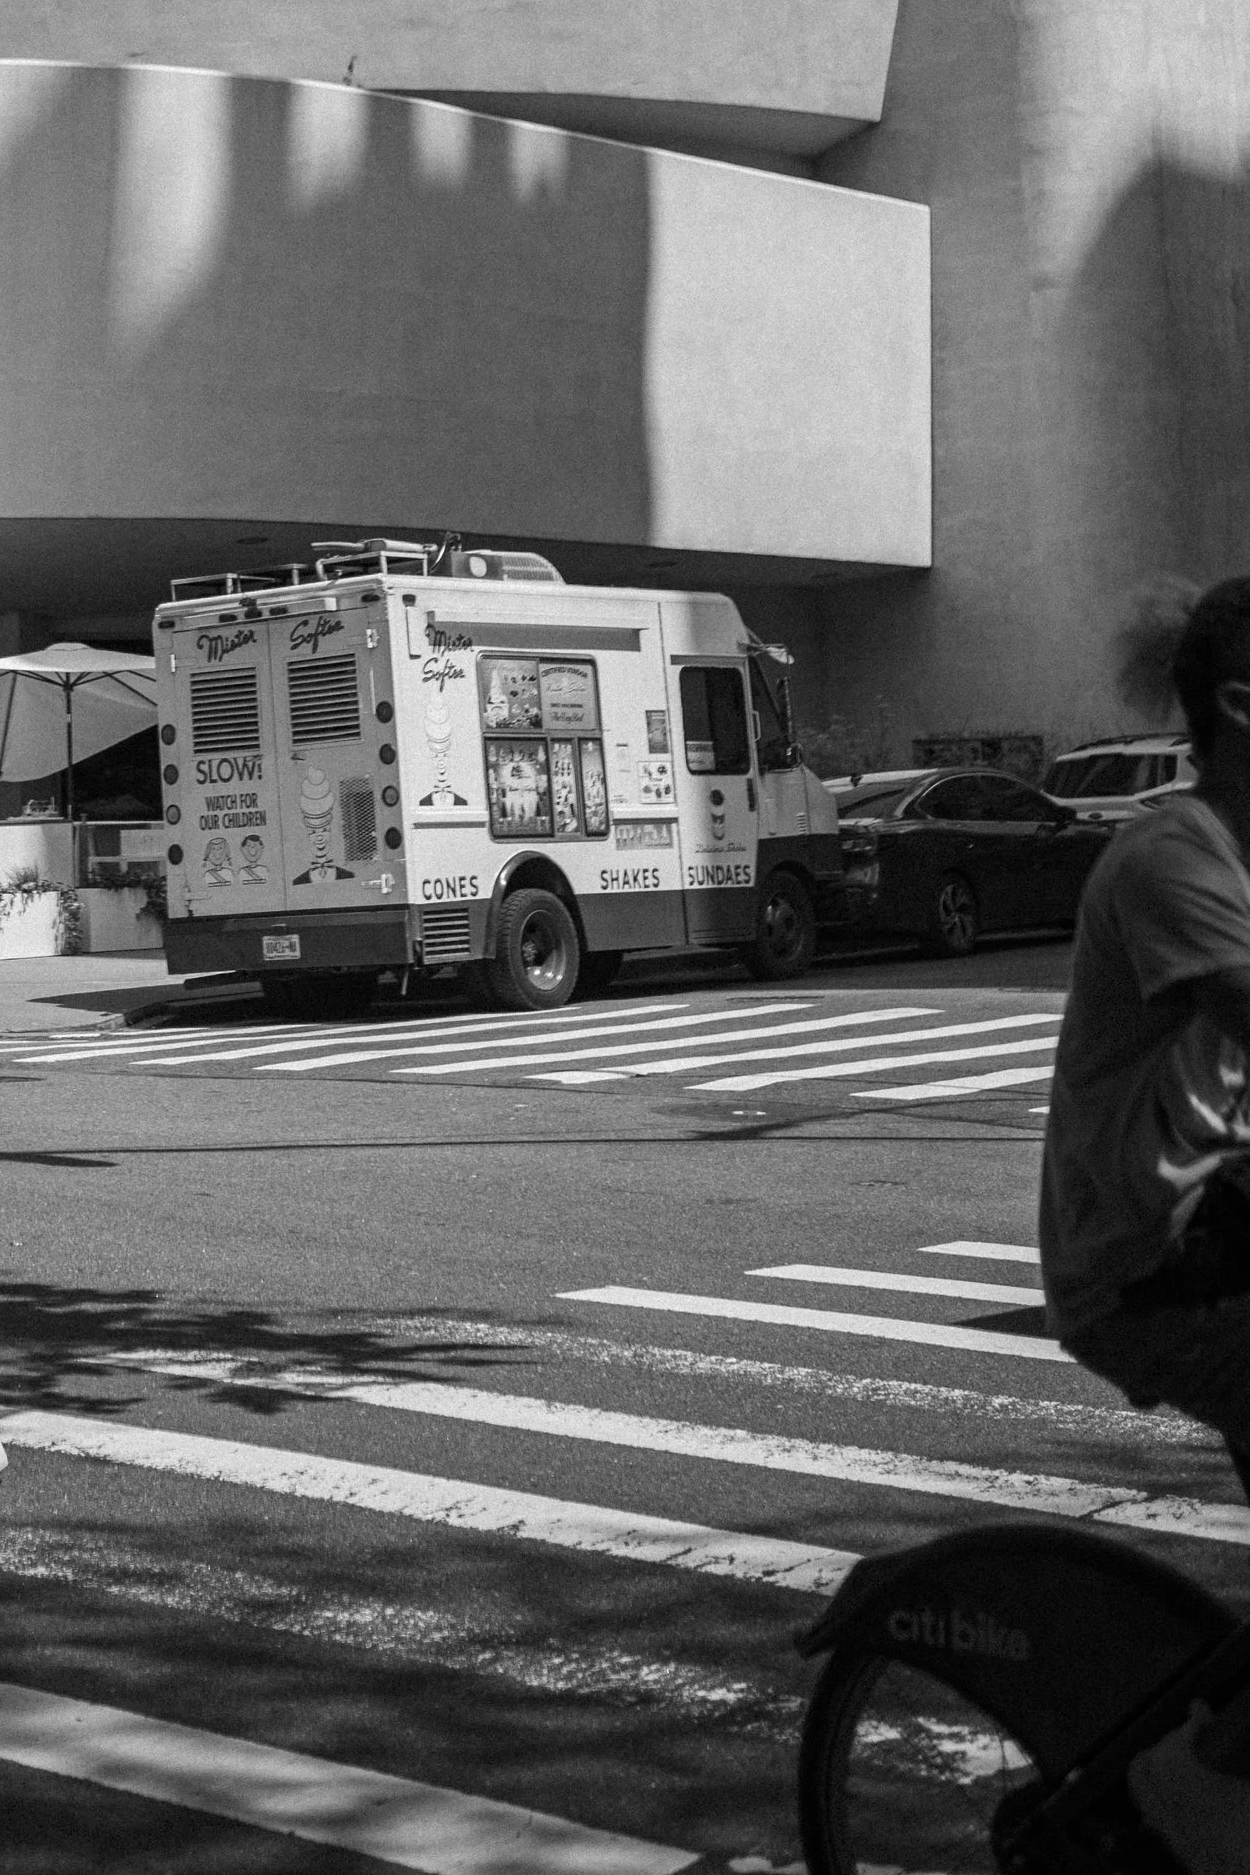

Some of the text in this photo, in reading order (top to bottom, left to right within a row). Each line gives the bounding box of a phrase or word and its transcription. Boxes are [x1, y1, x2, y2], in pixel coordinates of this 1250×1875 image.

[196, 615, 345, 663] Mister Softee
[424, 623, 475, 657] Mister
[422, 657, 466, 693] Softee
[196, 756, 263, 785] SLOW!
[204, 792, 259, 812] WATCH FOR
[199, 809, 267, 831] OUR CHILDREN
[421, 875, 479, 901] CONES
[600, 867, 661, 891] SHAKES
[687, 864, 752, 887] SUNDAES
